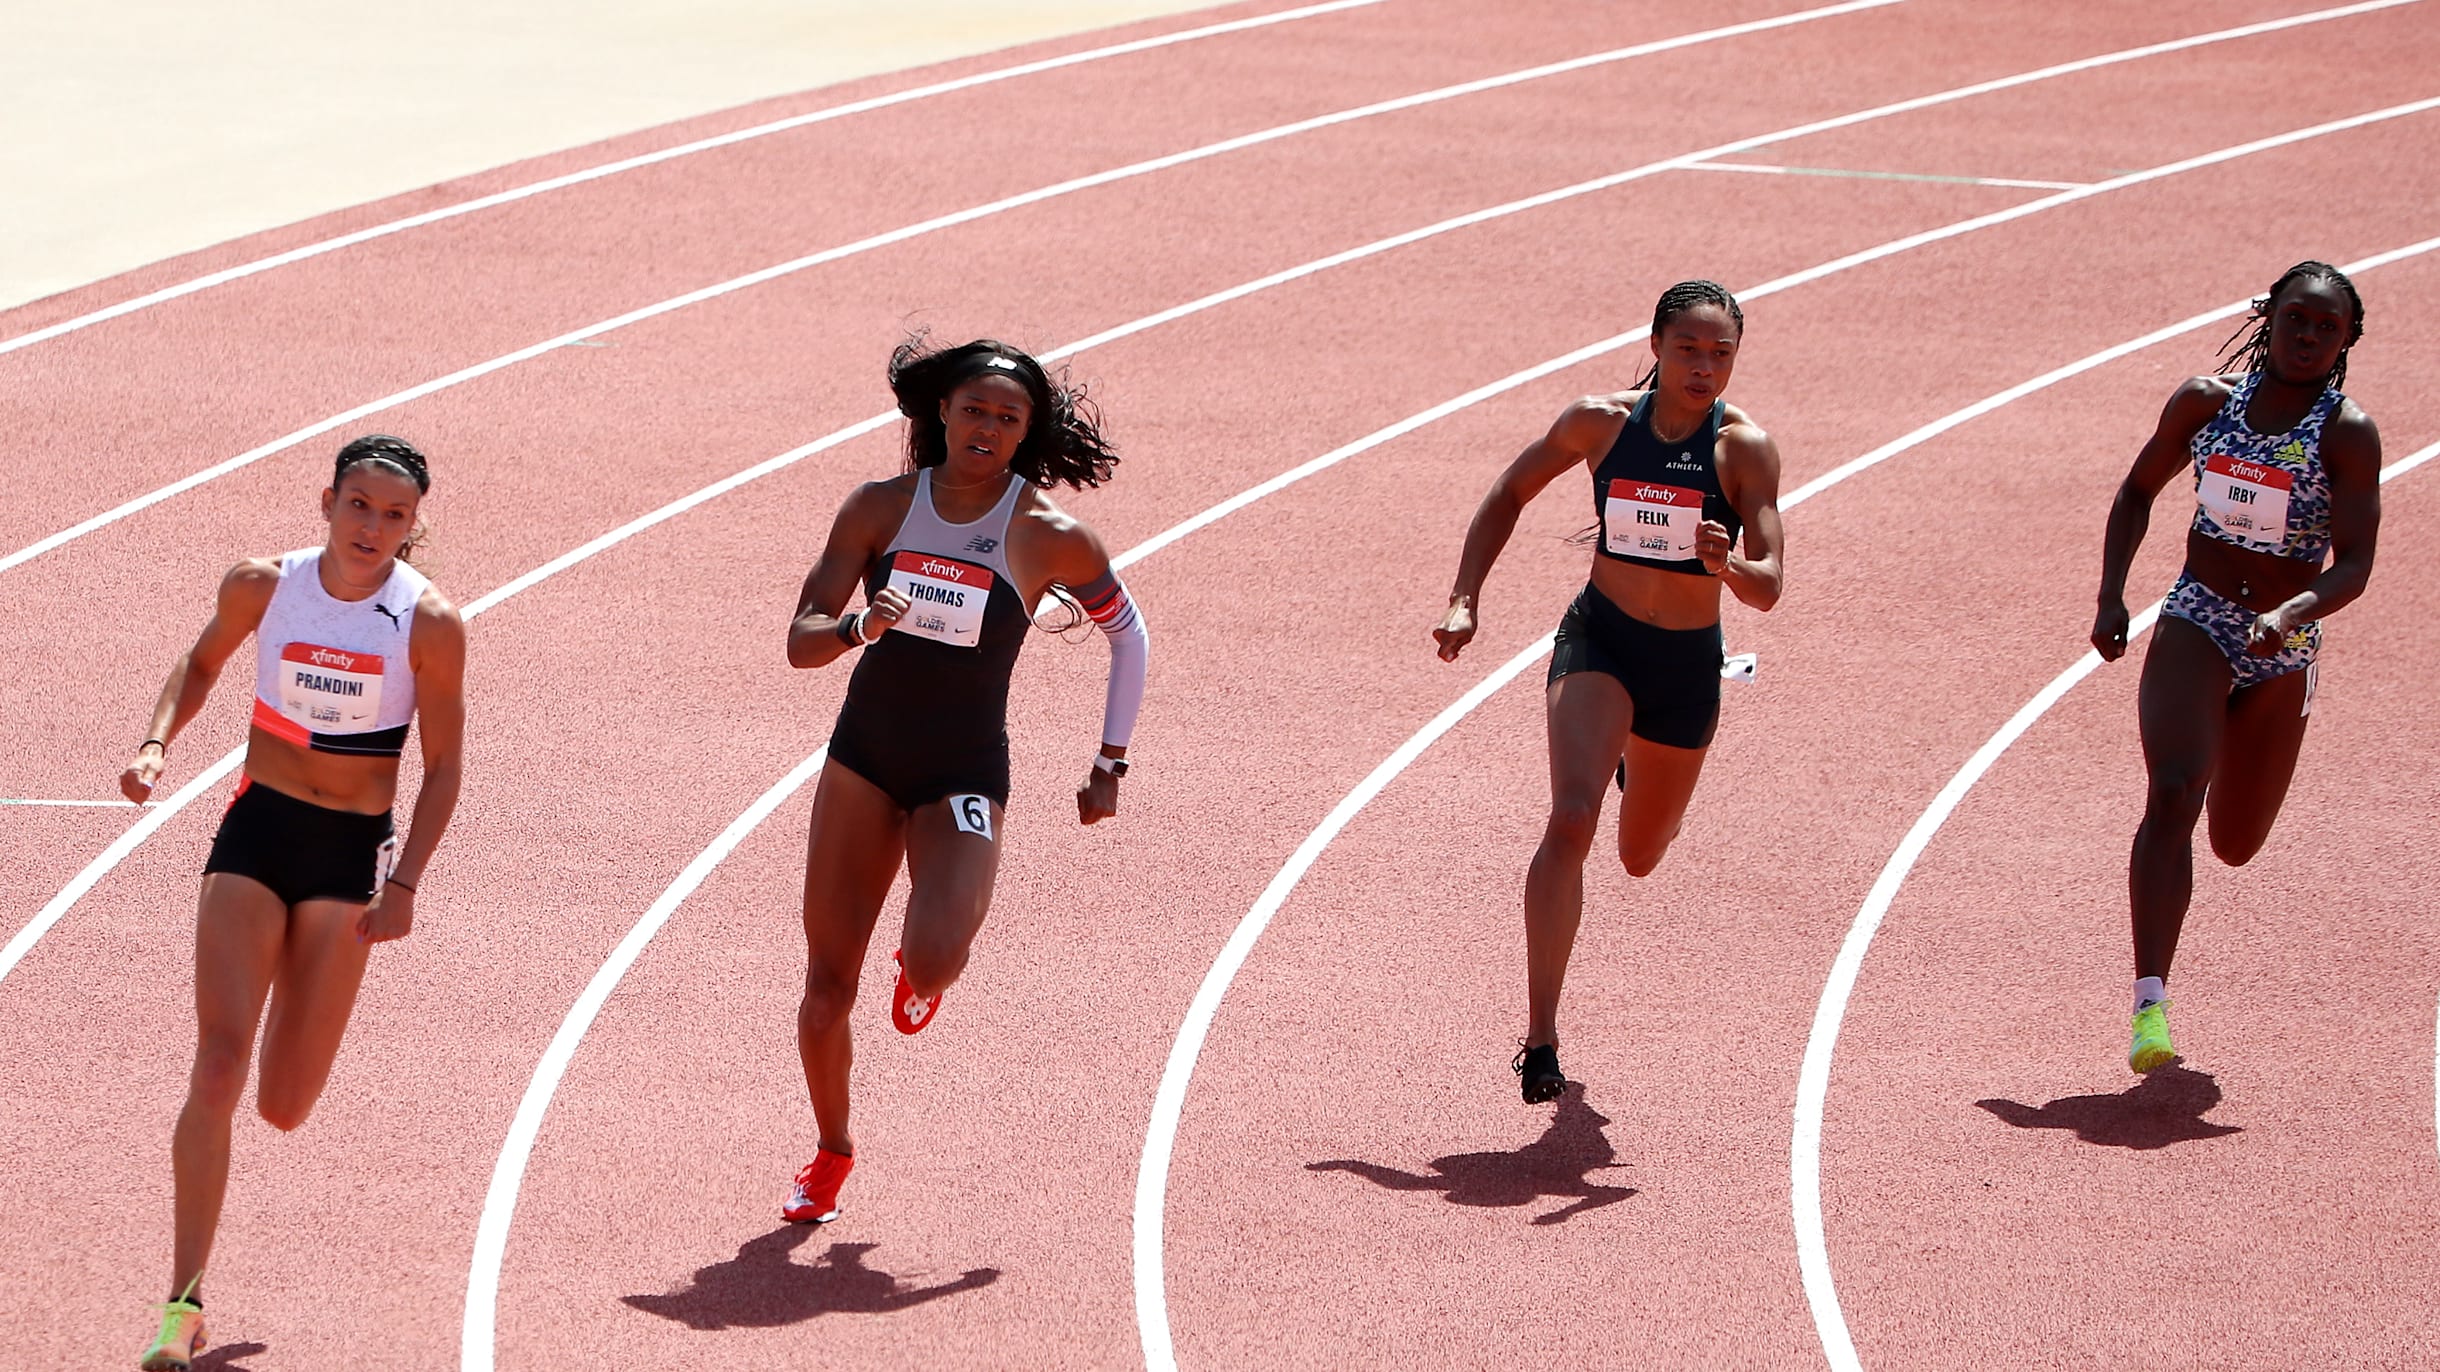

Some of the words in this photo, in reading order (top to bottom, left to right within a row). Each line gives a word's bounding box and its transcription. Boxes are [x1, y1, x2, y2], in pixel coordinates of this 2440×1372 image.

[1665, 461, 1703, 472] ATHLETA
[2228, 462, 2267, 482] xfinity
[1634, 485, 1678, 504] xfinity
[2228, 485, 2257, 505] IRBY
[1636, 510, 1670, 528] FELIX
[2224, 520, 2253, 530] GAMES
[1639, 542, 1668, 552] GAMES
[920, 560, 965, 581] xfinity
[908, 582, 965, 608] THOMAS
[915, 621, 946, 633] GAMES
[310, 648, 355, 670] xfinity
[295, 672, 364, 697] PRANDINI
[310, 713, 341, 724] GAMES
[963, 796, 985, 832] 6
